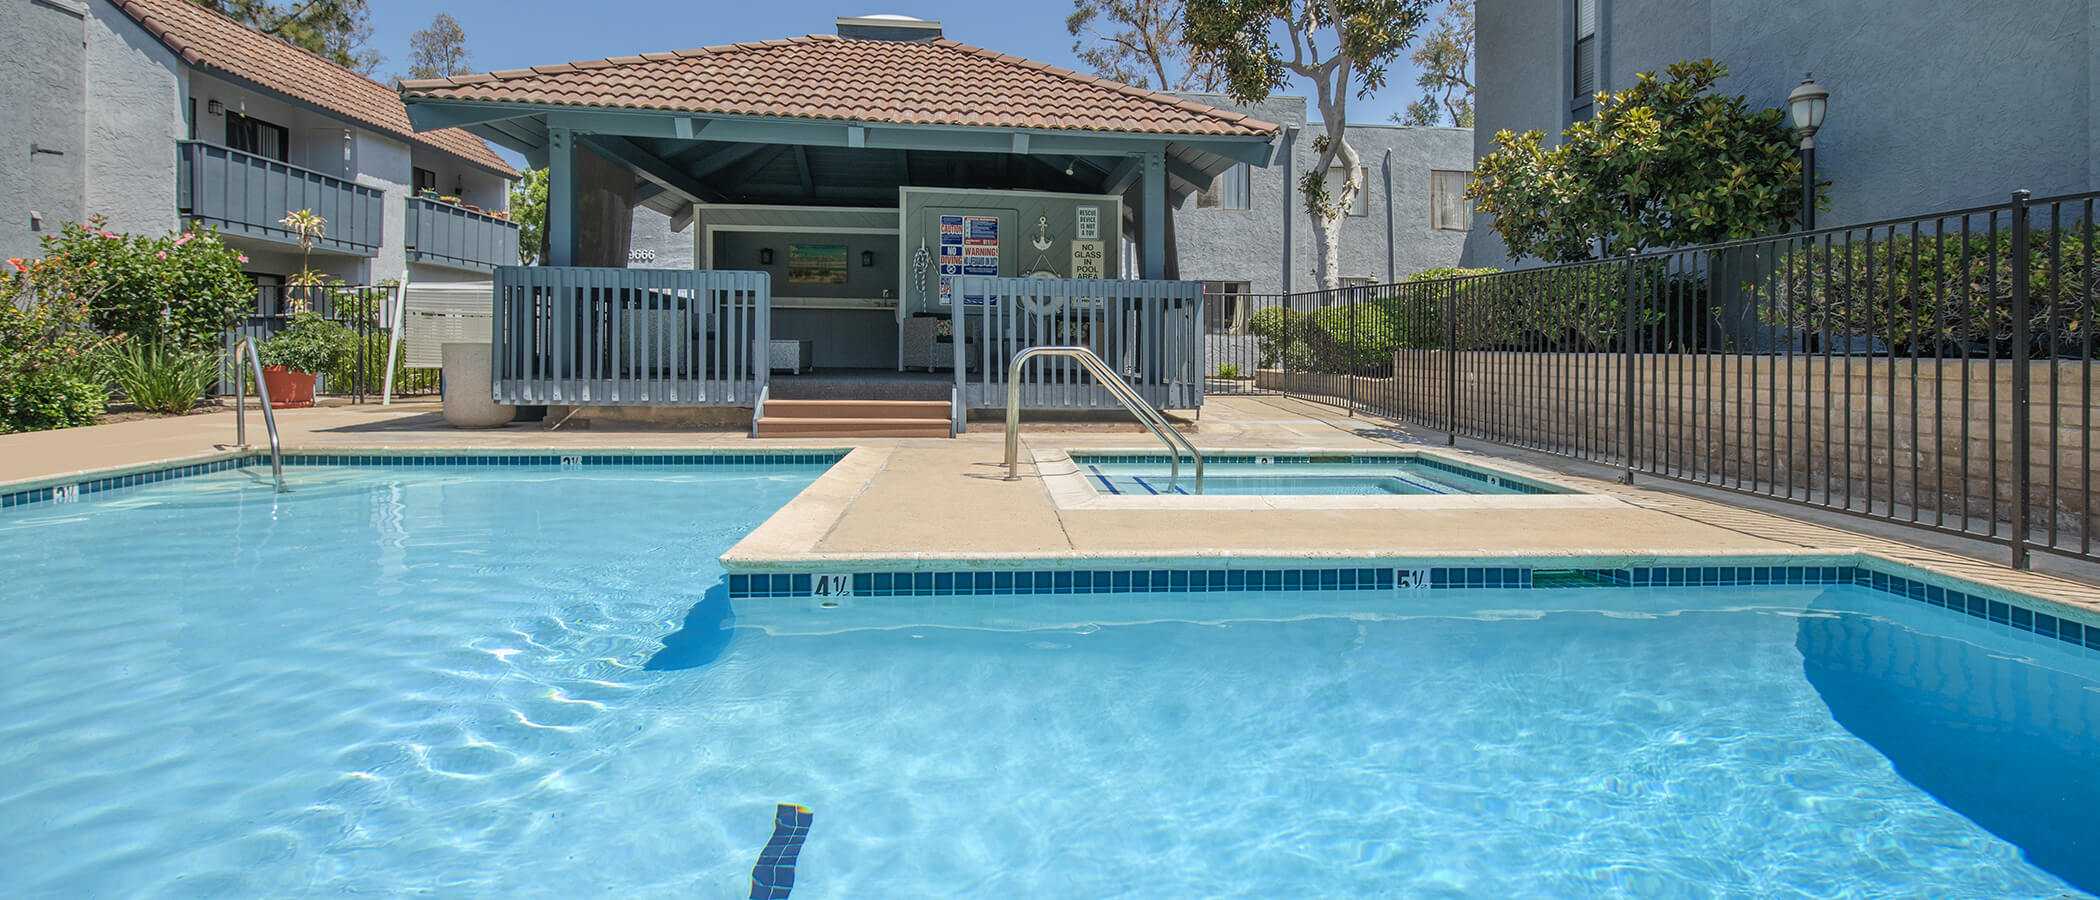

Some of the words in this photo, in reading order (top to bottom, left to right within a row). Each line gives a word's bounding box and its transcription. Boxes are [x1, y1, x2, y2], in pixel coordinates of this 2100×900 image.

[941, 224, 963, 233] CAUTION
[947, 247, 957, 256] NO
[965, 247, 999, 257] WARNING!
[1074, 251, 1102, 259] GLASS
[941, 256, 963, 265] DIVING
